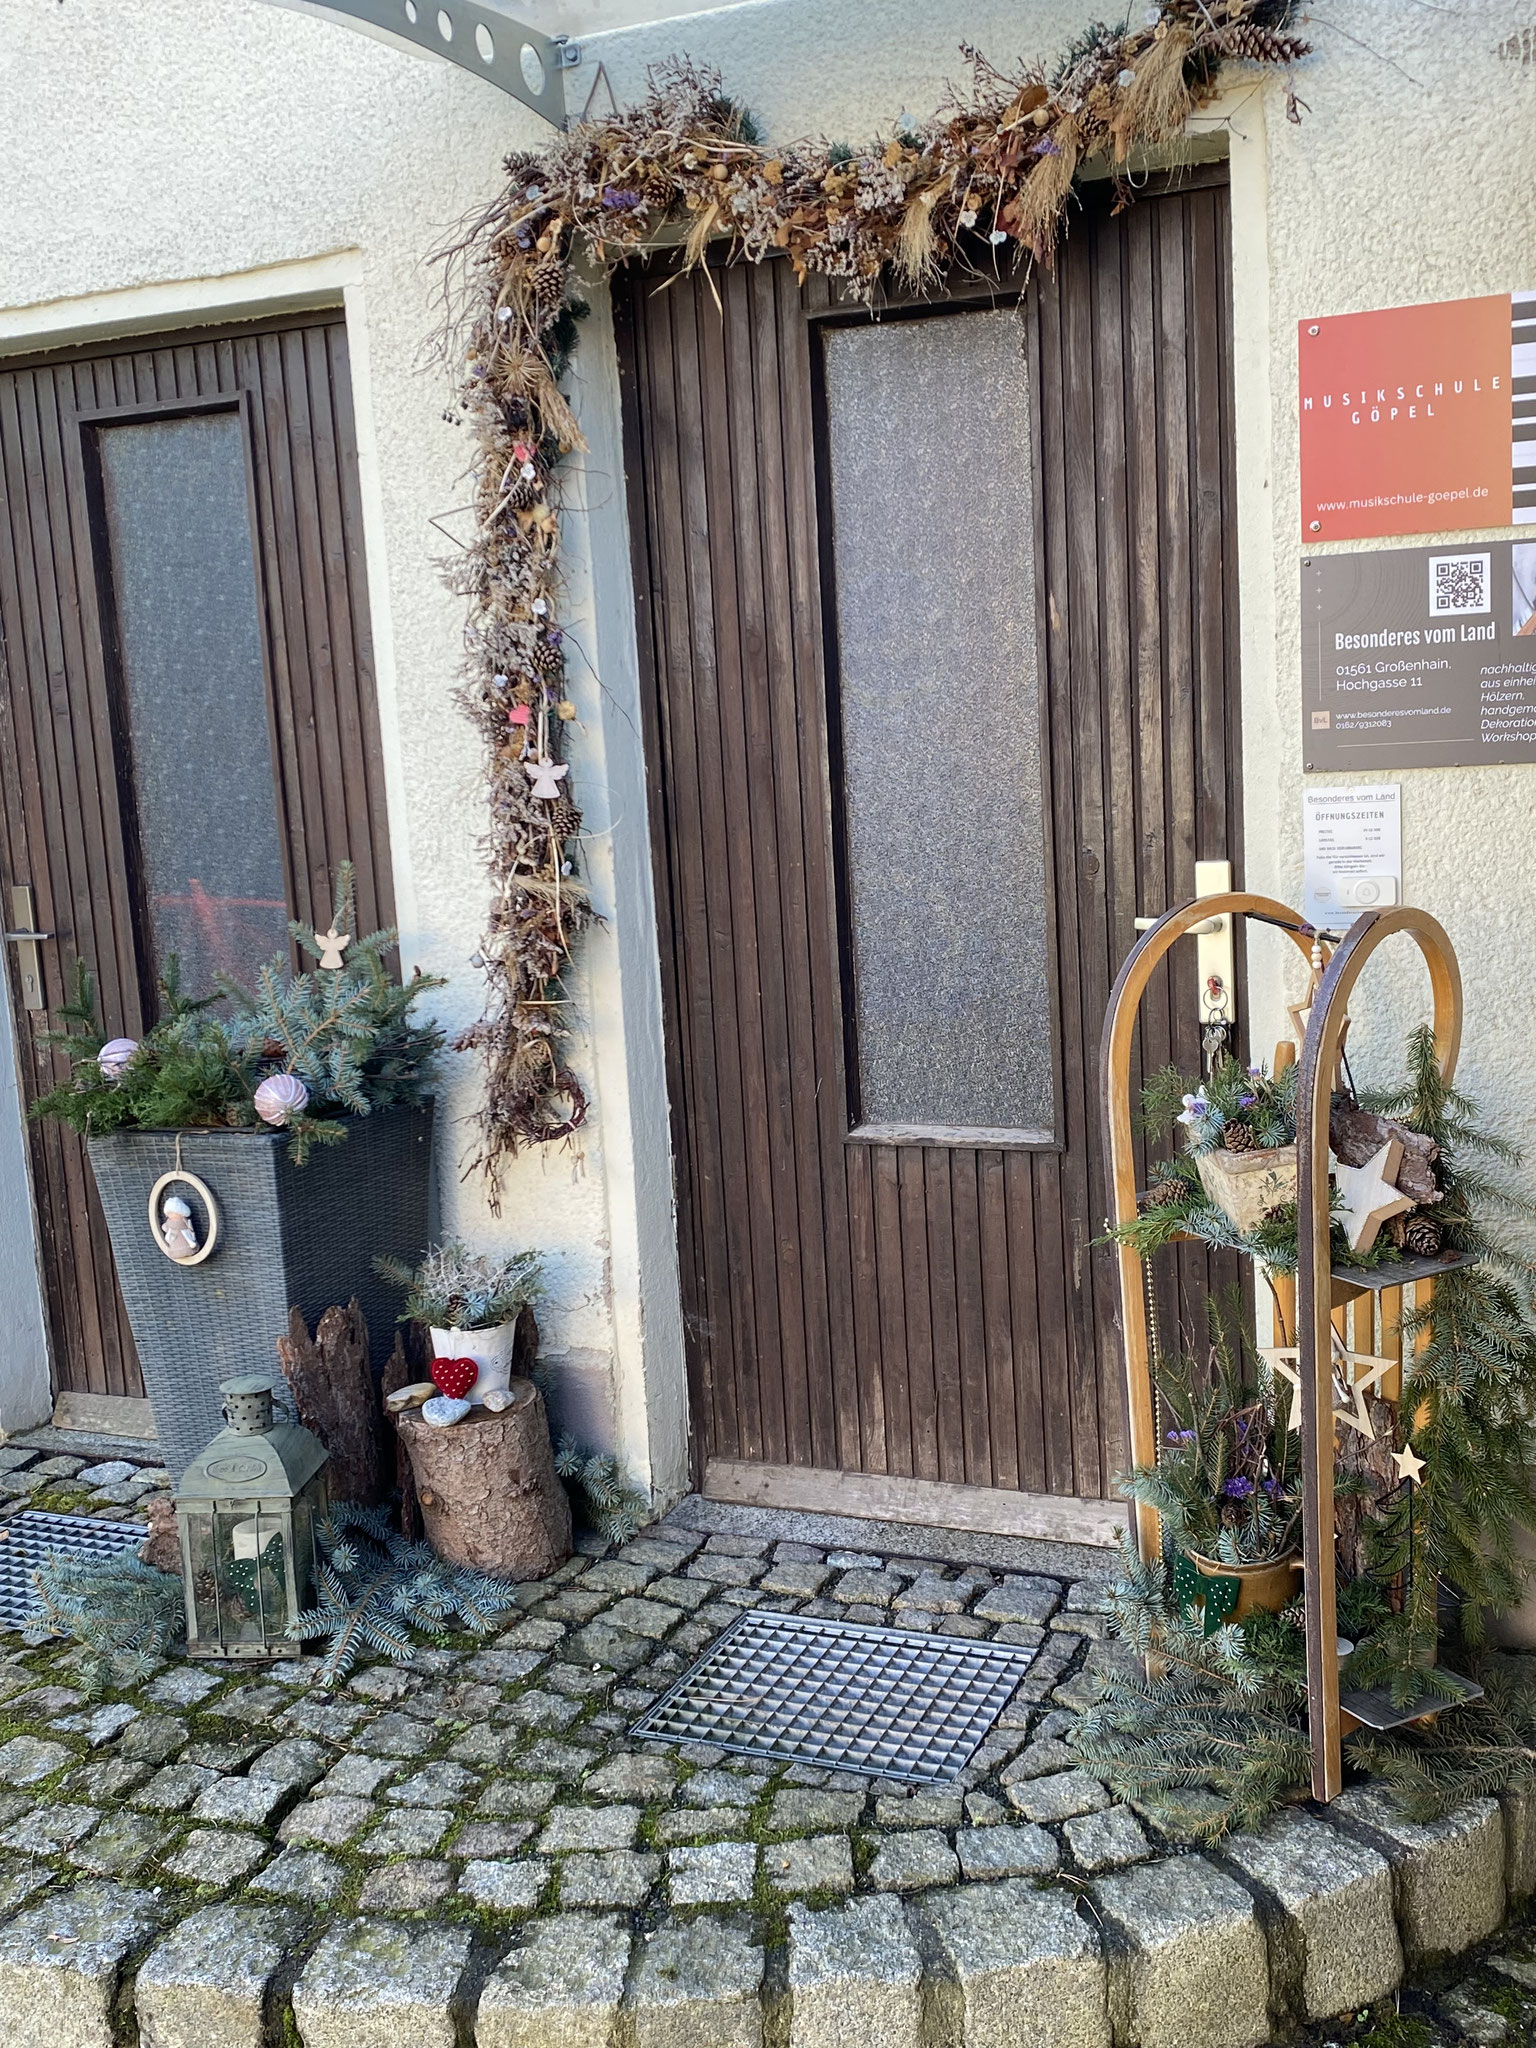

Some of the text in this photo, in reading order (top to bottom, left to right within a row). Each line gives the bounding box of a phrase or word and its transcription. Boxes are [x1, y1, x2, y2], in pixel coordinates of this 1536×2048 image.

[1304, 376, 1500, 410] MUSIKSCHULE
[1352, 403, 1435, 424] GÖPEL
[1316, 486, 1489, 512] www.musikschule-goepel.de
[1335, 621, 1496, 650] Besonderes vom Land
[1336, 664, 1372, 677] 01561
[1336, 677, 1423, 692] Hochgasse 11
[1480, 680, 1501, 689] aus
[1335, 706, 1452, 719] www.besonderesvomland.de
[1308, 795, 1355, 803] Besonderes
[1376, 792, 1396, 800] Land
[1316, 811, 1384, 821] ÖFFNUNGSZEITEN
